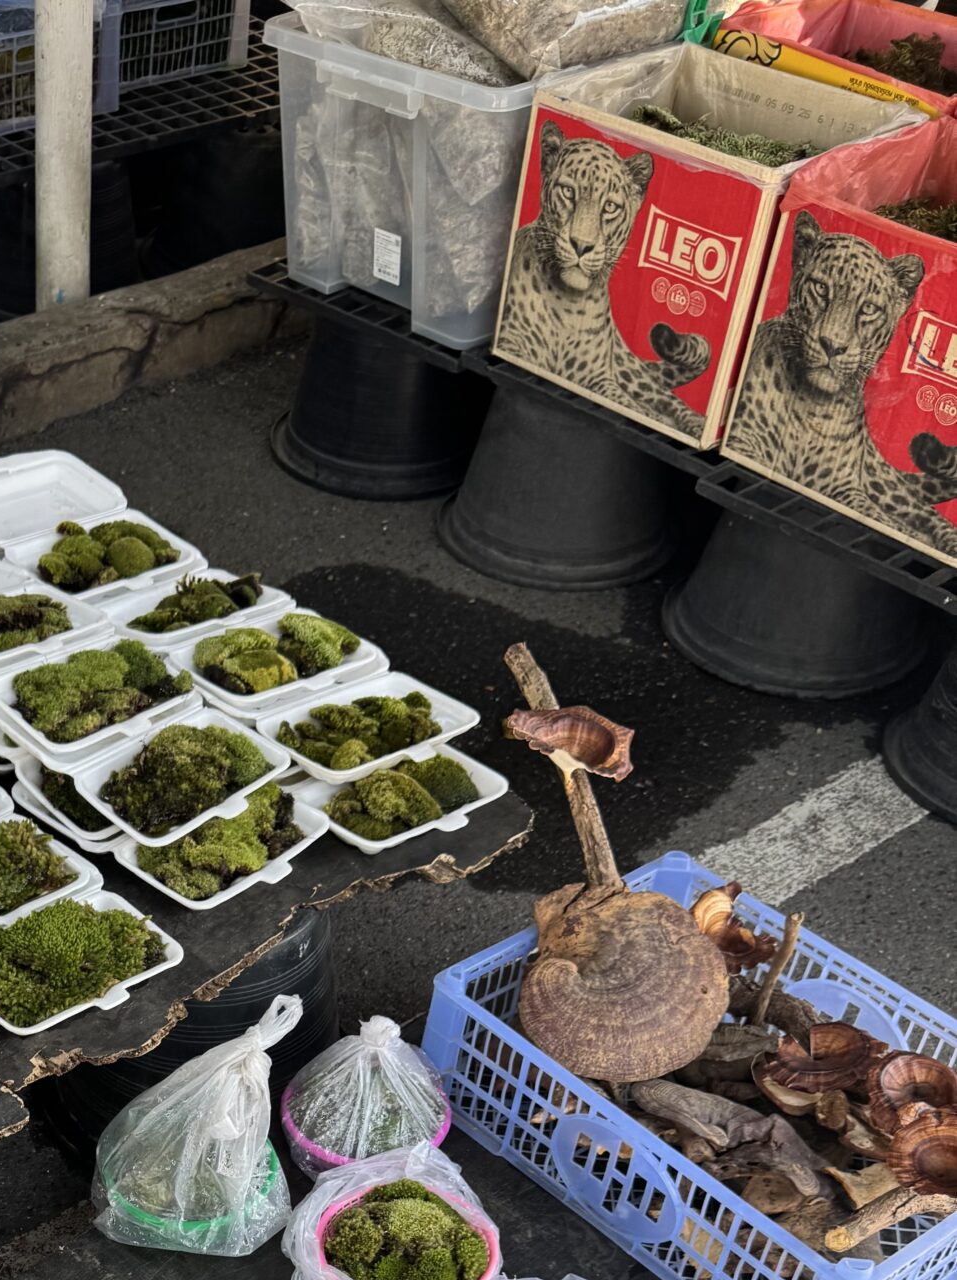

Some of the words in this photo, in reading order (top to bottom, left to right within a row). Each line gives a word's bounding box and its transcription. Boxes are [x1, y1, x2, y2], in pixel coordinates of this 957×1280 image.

[765, 97, 777, 109] 05
[781, 102, 795, 114] 09
[797, 107, 812, 119] 25
[648, 217, 730, 284] LEO
[670, 291, 687, 306] LEO
[939, 401, 957, 417] LEO
